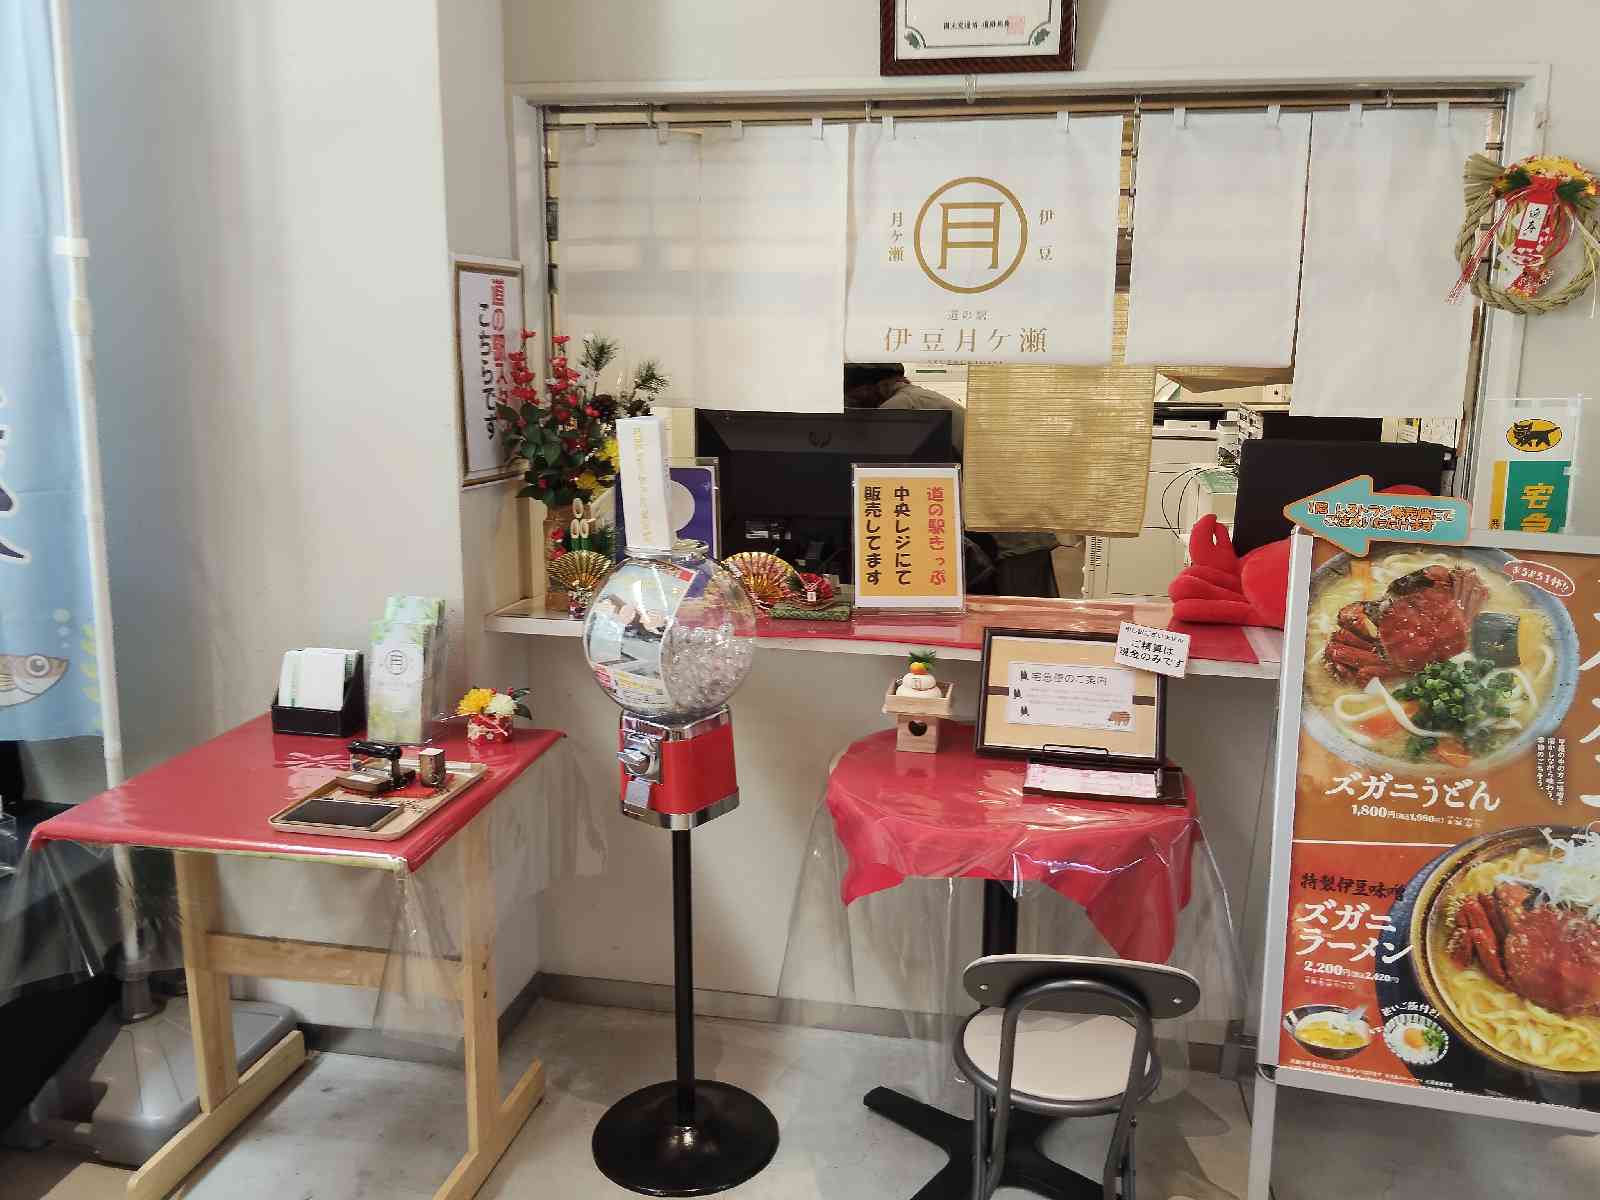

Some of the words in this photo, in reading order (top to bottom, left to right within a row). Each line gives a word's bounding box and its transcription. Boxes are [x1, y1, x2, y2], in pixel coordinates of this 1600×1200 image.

[1039, 209, 1056, 261] 伊豆
[863, 486, 882, 586] 販売してます
[893, 485, 912, 586] 中央レジにて
[926, 486, 946, 586] 道の駅きっぷ
[1325, 771, 1500, 812] ズガニうどん
[1296, 898, 1397, 932] ズガニ
[1296, 927, 1414, 964] ラーメン
